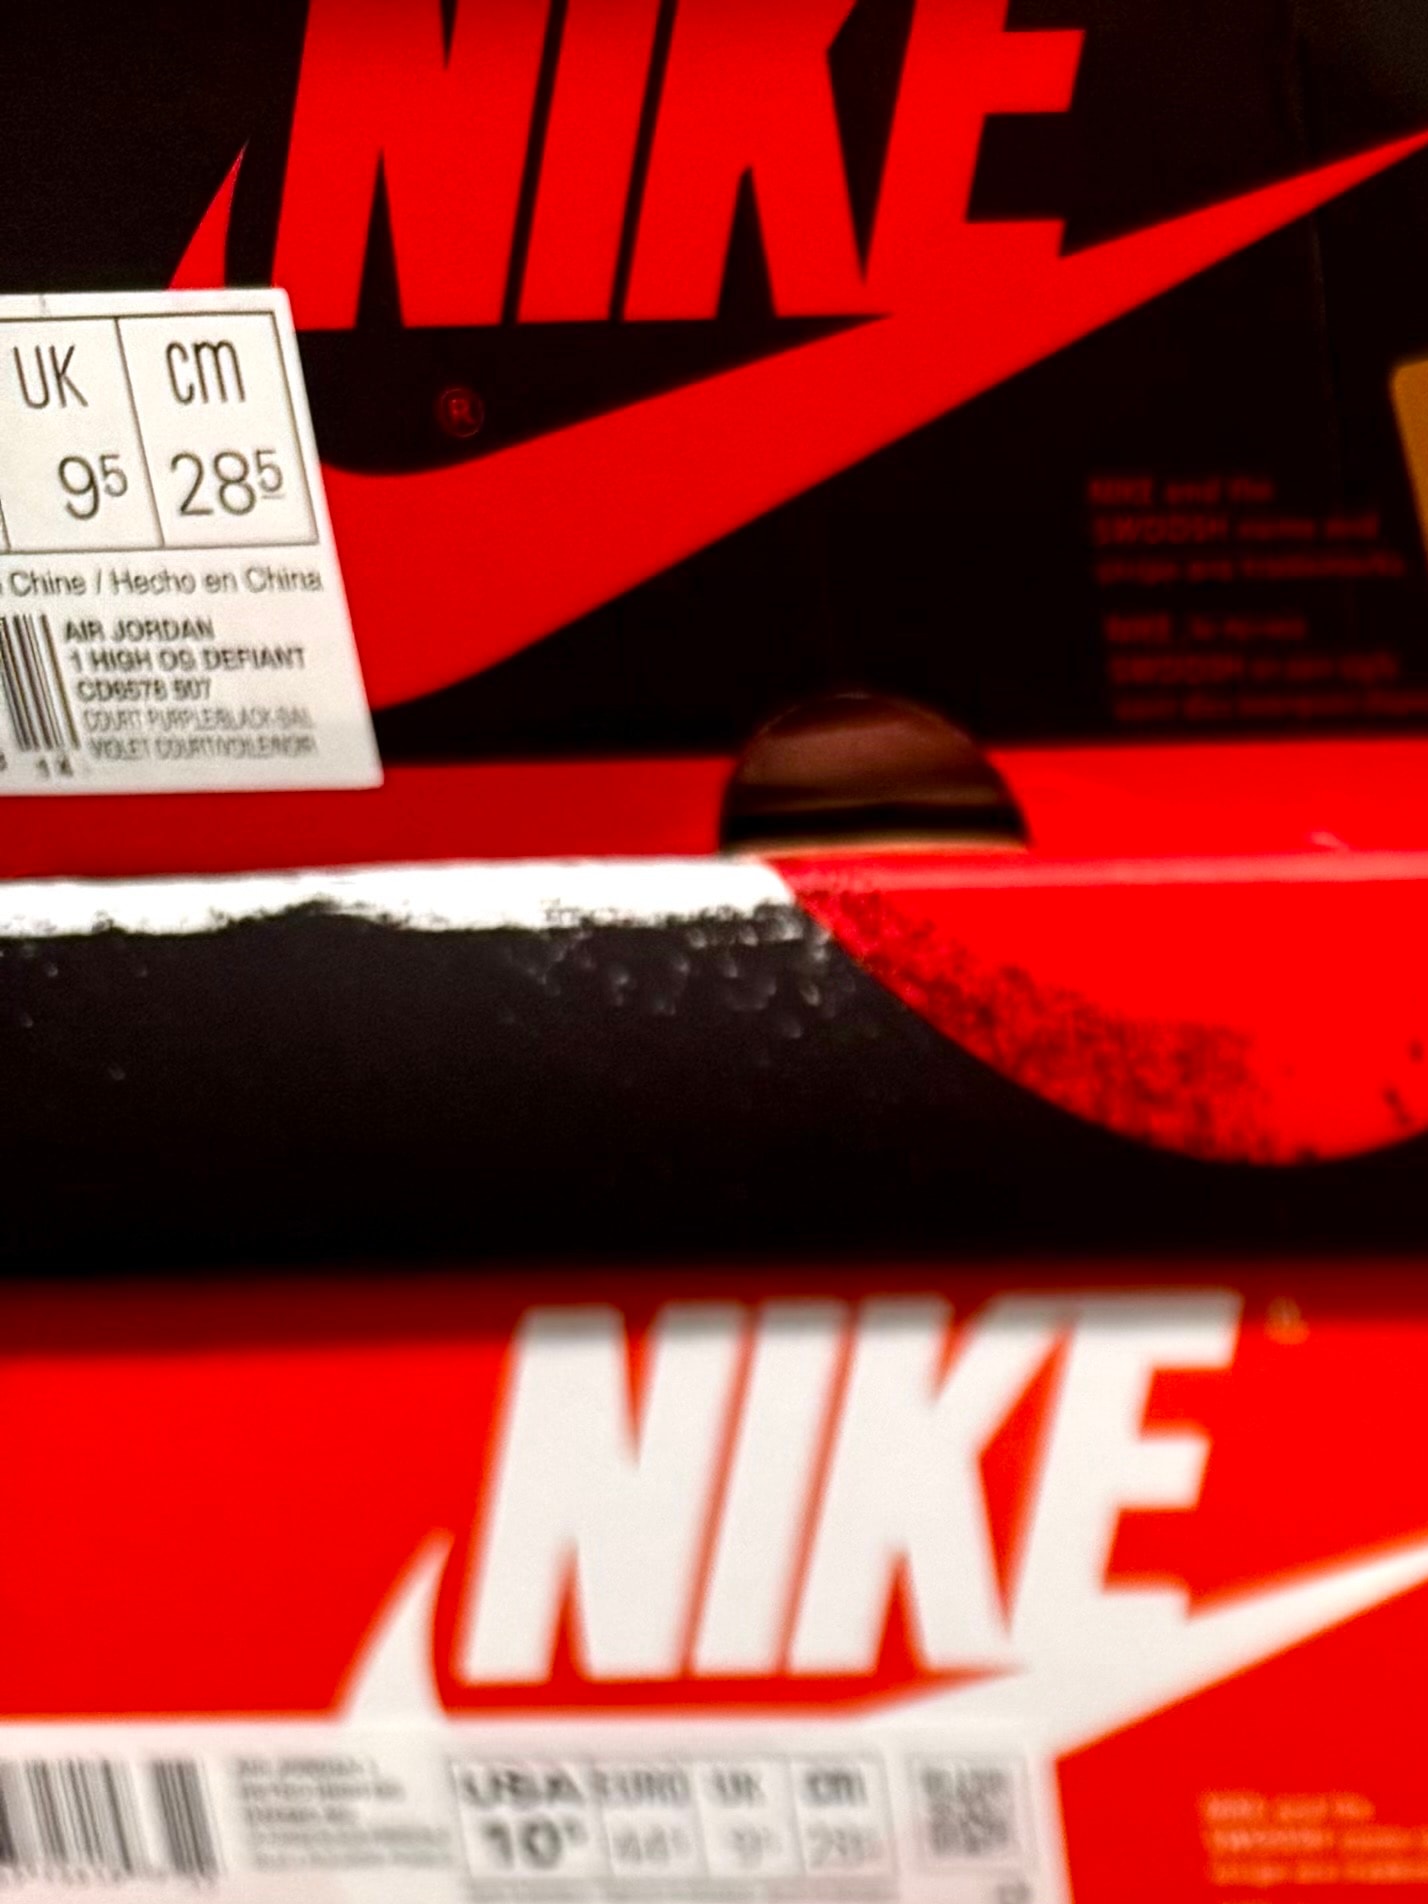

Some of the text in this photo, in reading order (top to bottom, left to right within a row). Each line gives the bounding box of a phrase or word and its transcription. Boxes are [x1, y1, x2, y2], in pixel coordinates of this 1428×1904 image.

[12, 338, 247, 410] UK cm
[9, 568, 87, 598] Chine
[110, 566, 198, 595] Hecho
[204, 570, 237, 595] en
[243, 565, 322, 594] China
[64, 616, 216, 642] AIR JORDAN
[70, 649, 83, 673] 1
[88, 648, 152, 673] HIGH
[202, 645, 306, 671] DEFIANT
[453, 1290, 1243, 1687] NIKE
[463, 1767, 584, 1806] USA
